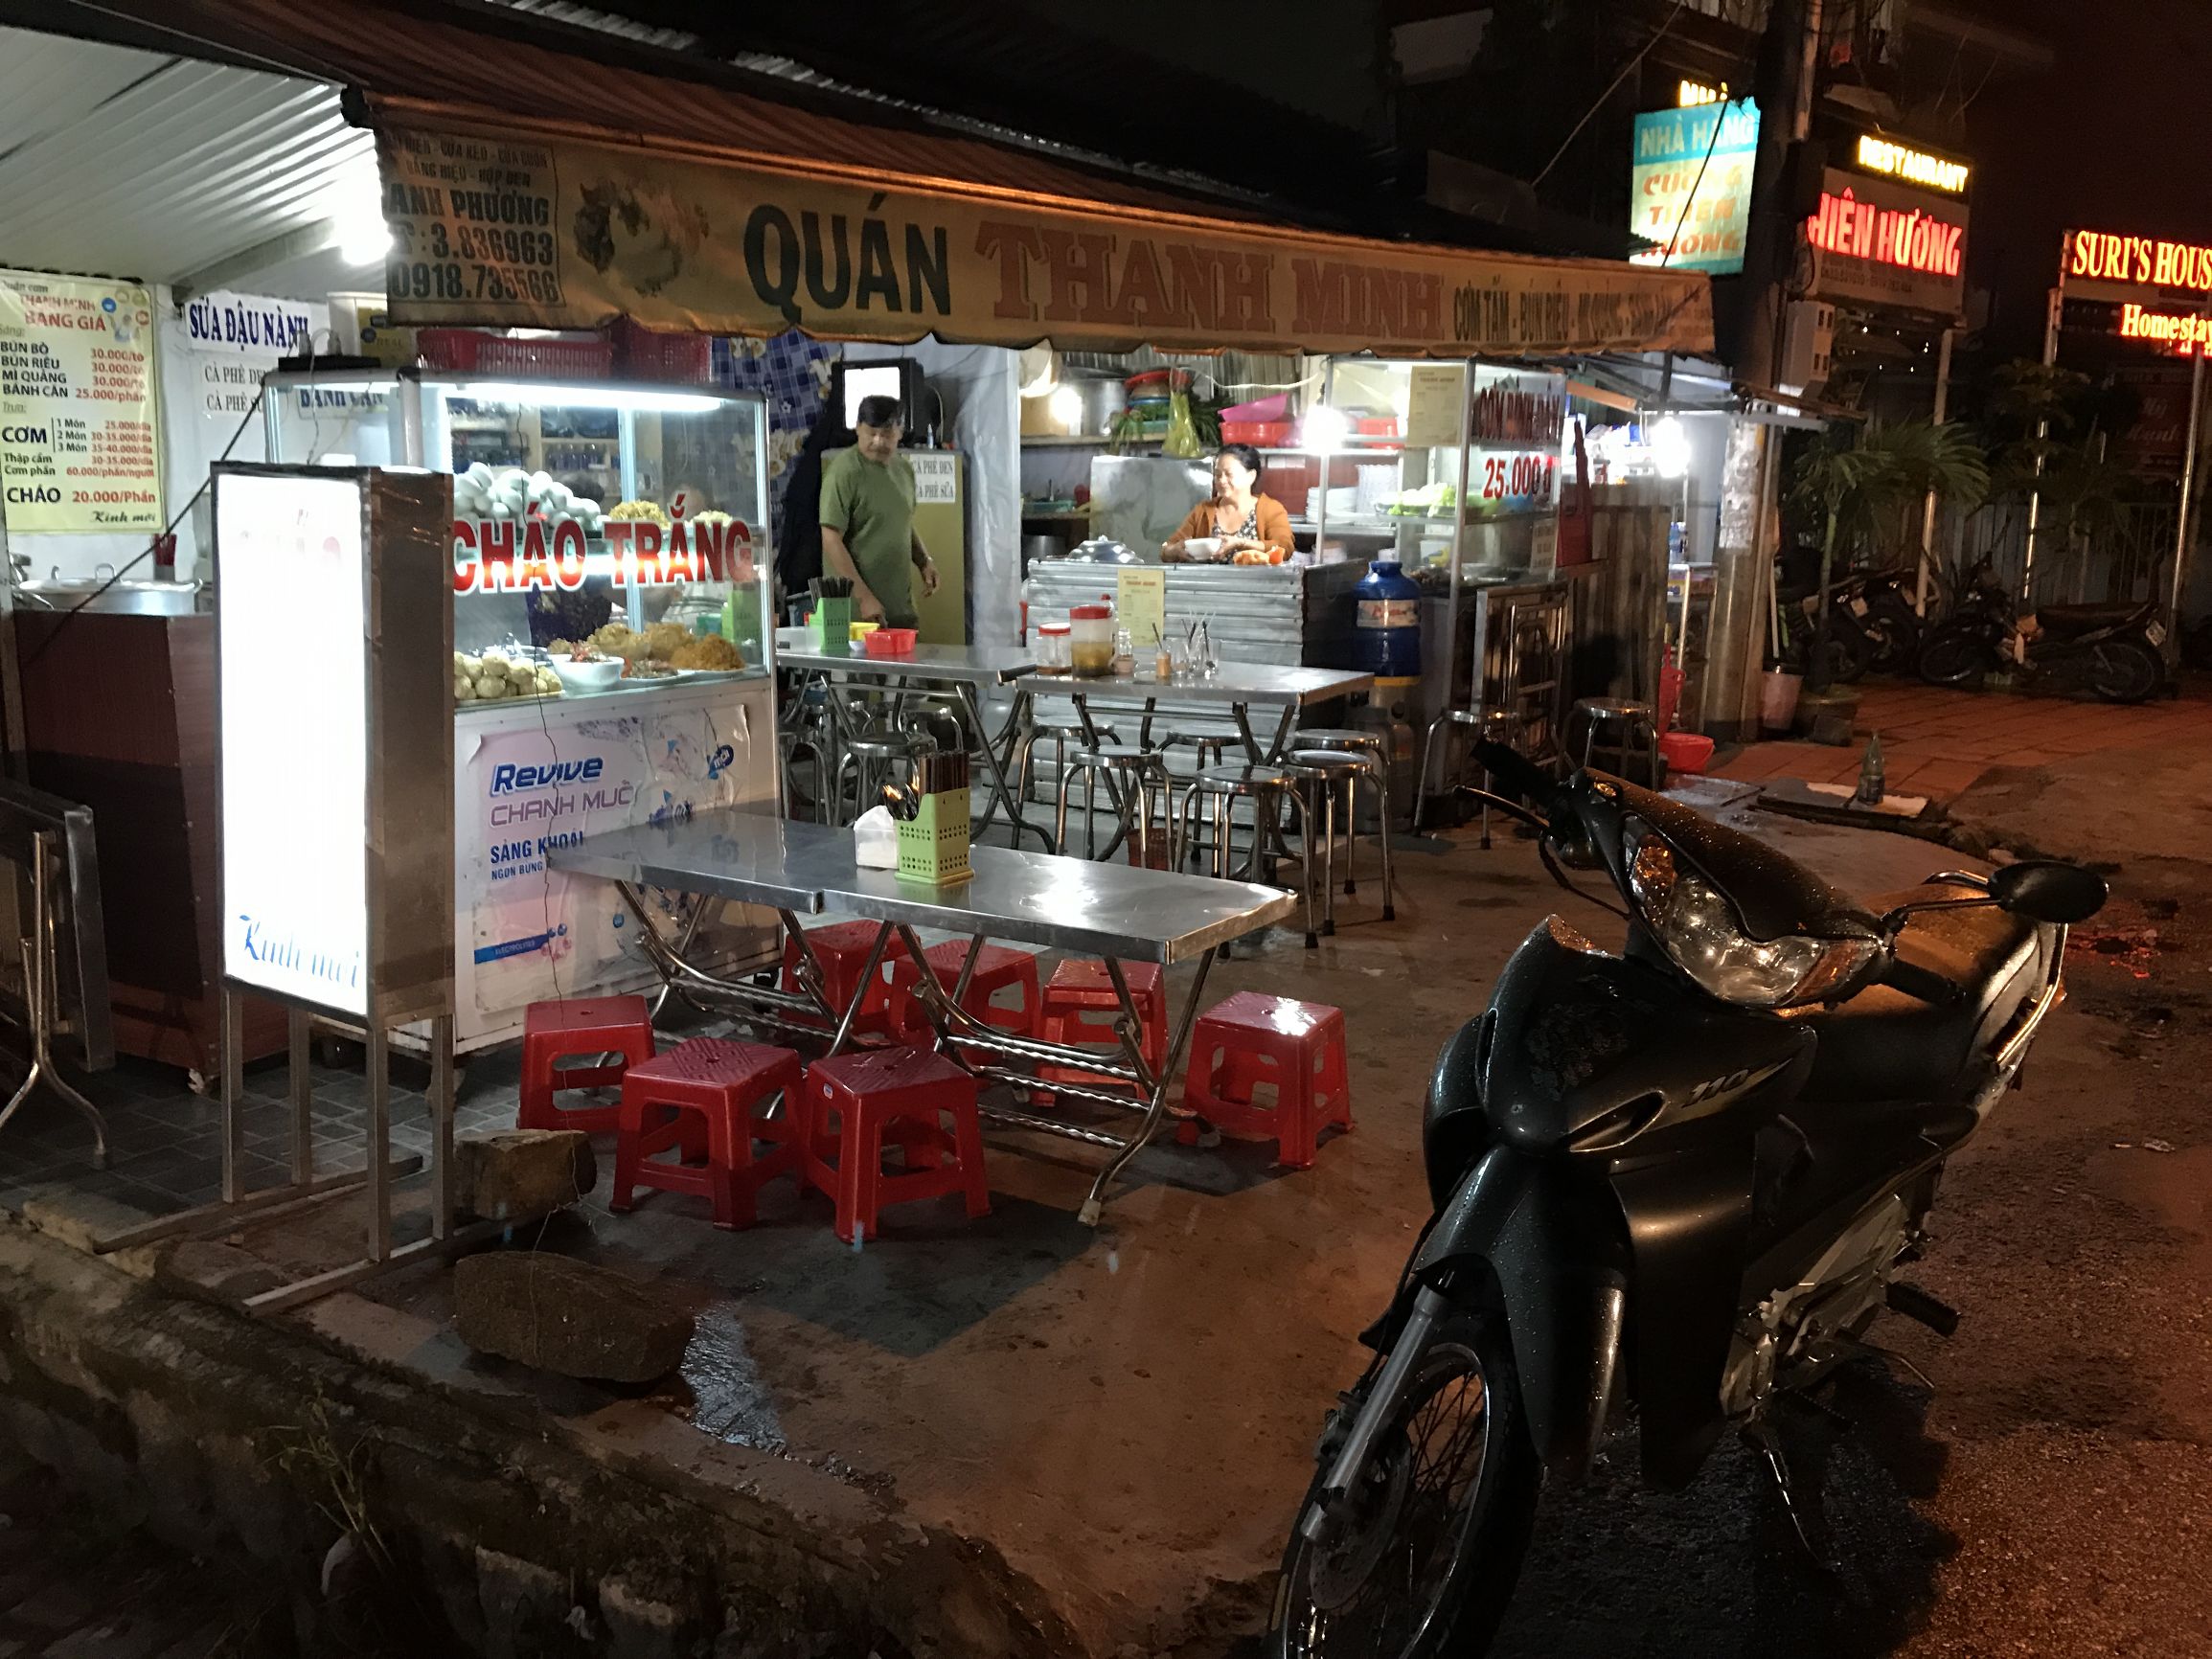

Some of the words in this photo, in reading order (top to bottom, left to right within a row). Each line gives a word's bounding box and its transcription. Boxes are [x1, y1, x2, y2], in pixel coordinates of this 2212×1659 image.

[1859, 135, 1968, 192] RESTAURANT
[1808, 186, 1875, 258] HIÊN
[1876, 208, 1962, 276] HƯƠNG
[743, 192, 951, 325] QUÁN
[974, 219, 1276, 334] THANH
[1291, 258, 1445, 340] MINH
[2072, 230, 2152, 282] SURI'S
[2154, 242, 2212, 290] HOUS
[225, 300, 260, 352] ĐẬU
[1, 425, 48, 444] CƠM
[7, 484, 61, 503] CHÁO
[1483, 456, 1540, 499] 25.000
[453, 501, 587, 594] CHÁO
[601, 493, 753, 588] TRẮNG
[492, 757, 604, 794] Revive
[490, 794, 576, 828] CHANH
[491, 865, 516, 880] NGON
